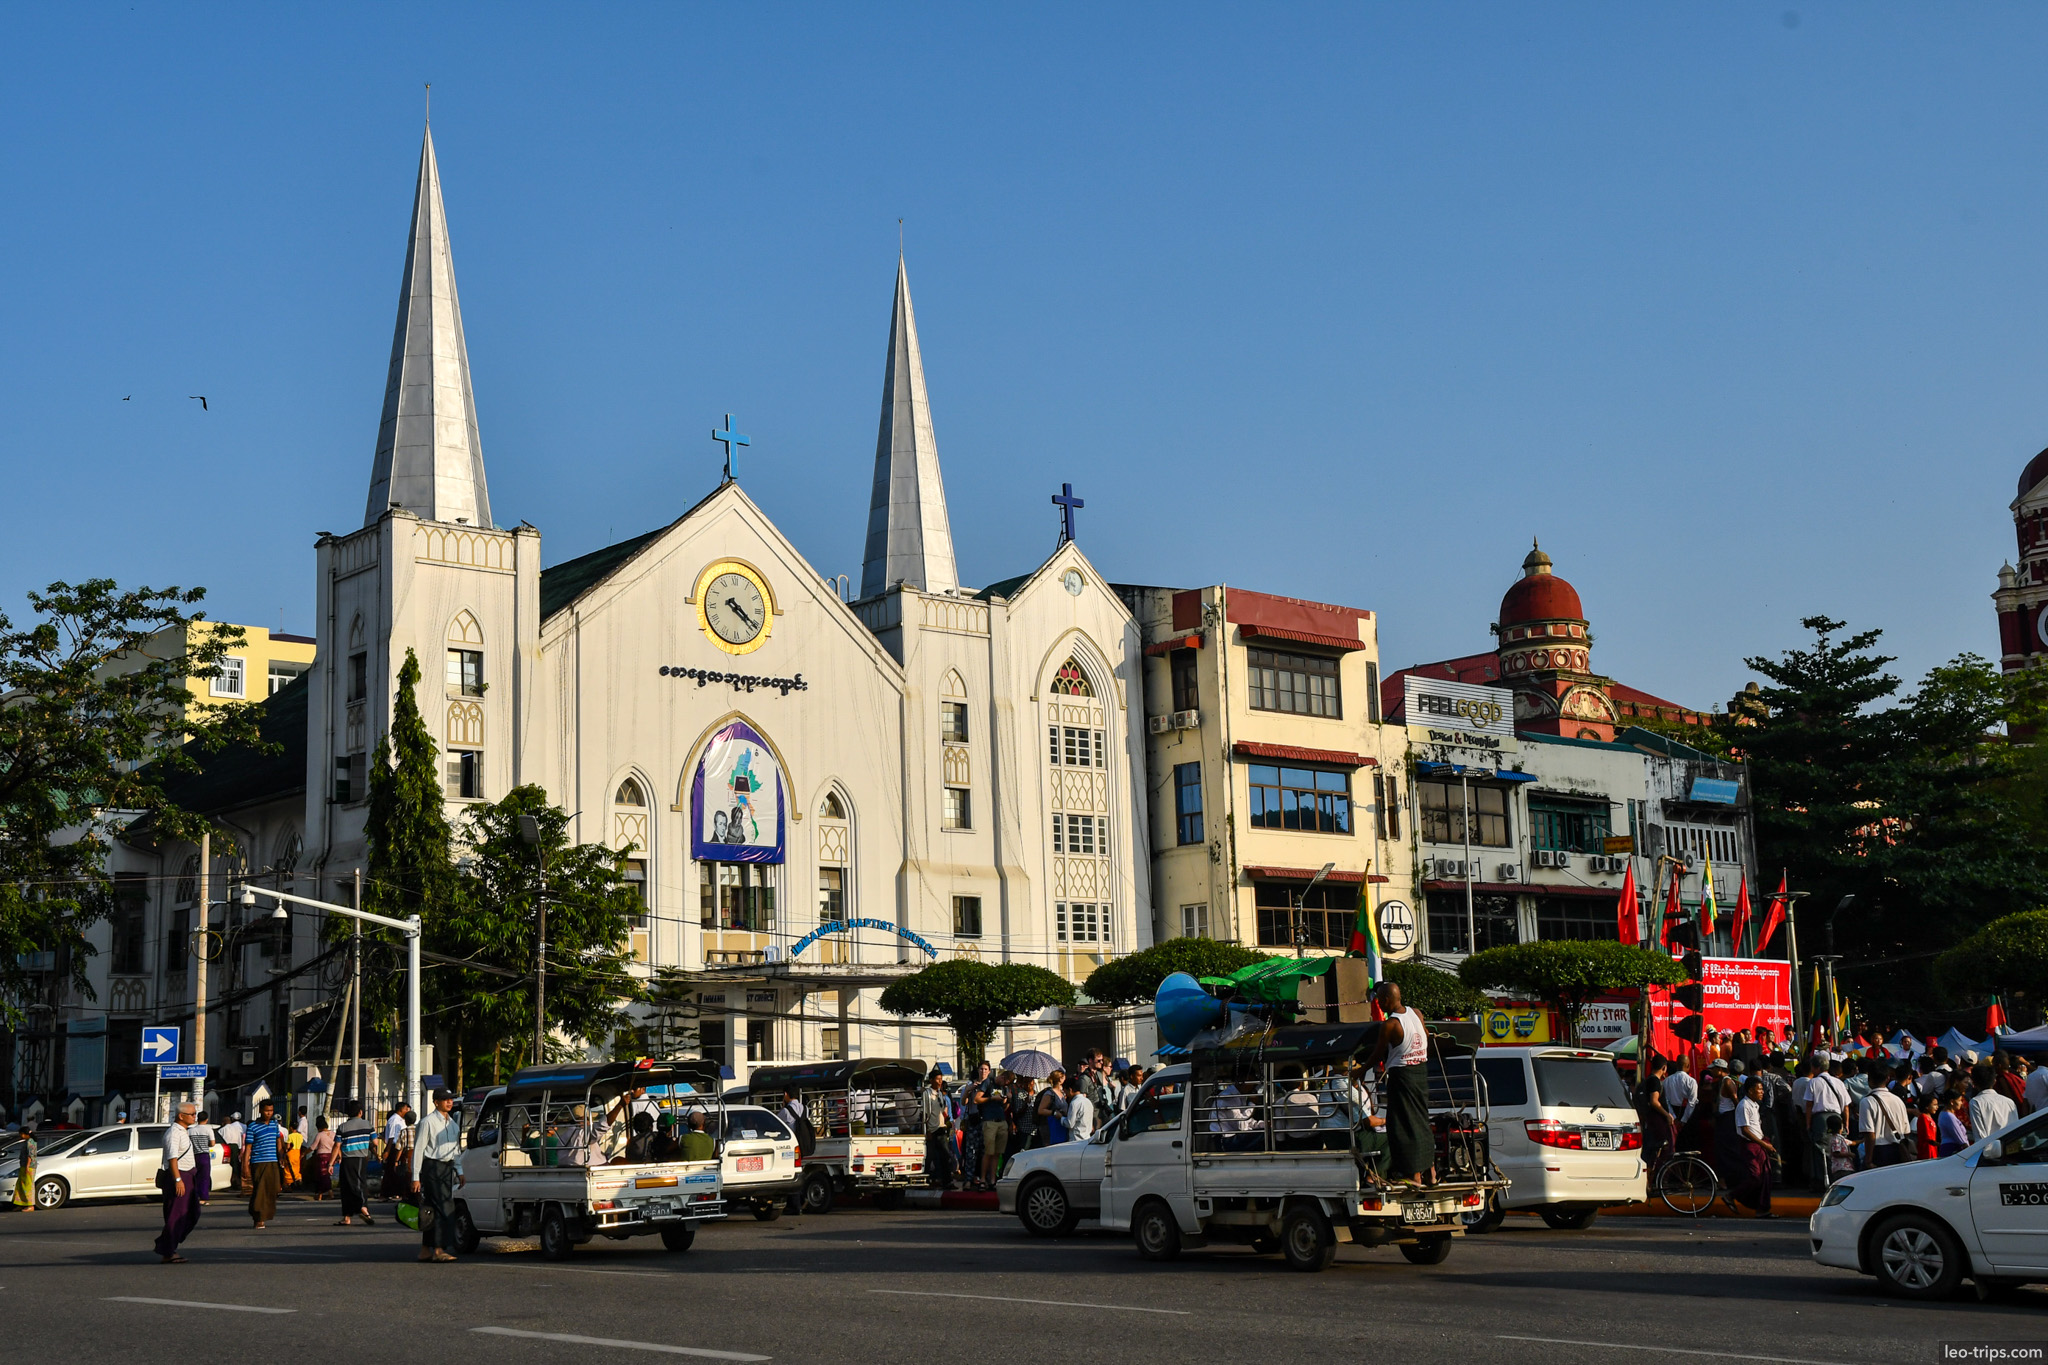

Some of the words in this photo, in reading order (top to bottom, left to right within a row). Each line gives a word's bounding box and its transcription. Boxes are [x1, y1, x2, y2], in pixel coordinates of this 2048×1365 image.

[1454, 732, 1463, 745] &
[791, 920, 845, 957] IMMANUEL
[847, 918, 895, 932] BAPTIST
[898, 927, 938, 960] CHURCH
[1603, 1009, 1628, 1022] STAR
[1493, 1020, 1510, 1030] STOP
[1603, 1025, 1623, 1033] DRINK
